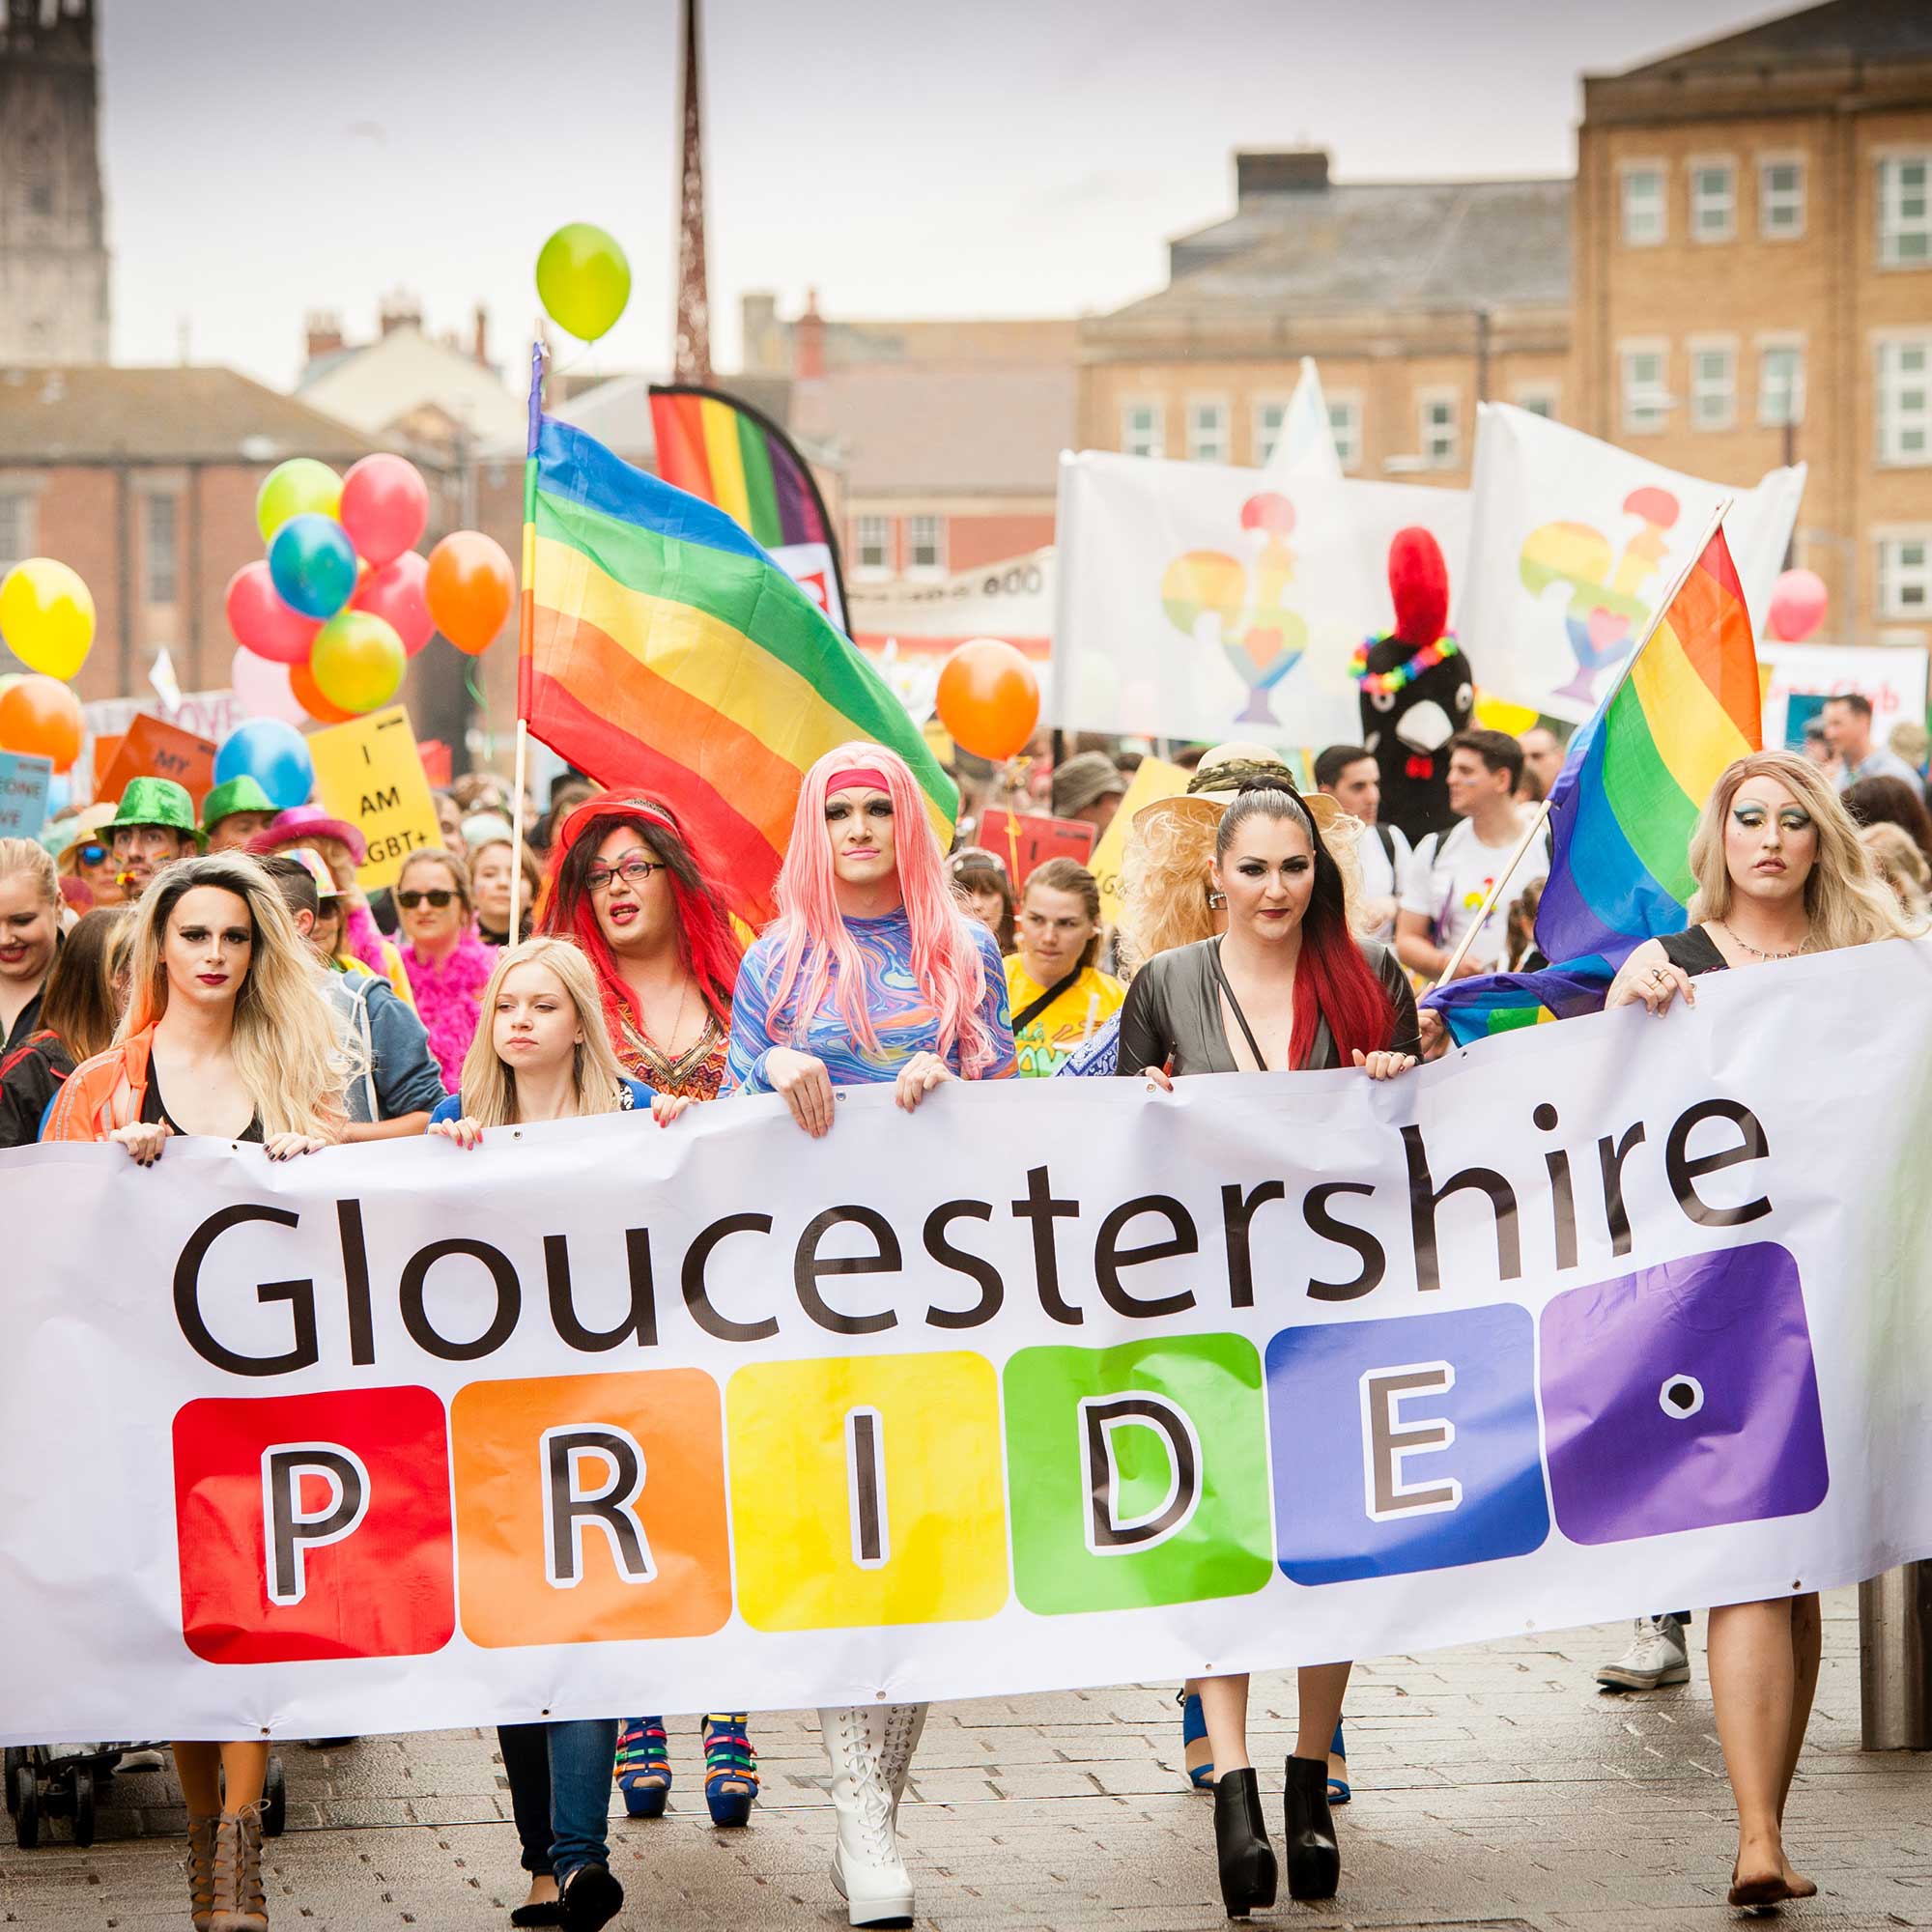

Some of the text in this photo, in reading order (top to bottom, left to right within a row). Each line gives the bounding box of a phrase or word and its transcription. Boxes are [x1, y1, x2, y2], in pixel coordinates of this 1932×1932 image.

[154, 748, 190, 774] MY
[361, 744, 371, 765] I
[360, 785, 401, 817] AM
[361, 830, 429, 867] GBT+
[174, 1097, 1774, 1377] Gloucestershire
[261, 1359, 1463, 1606] PRIDE
